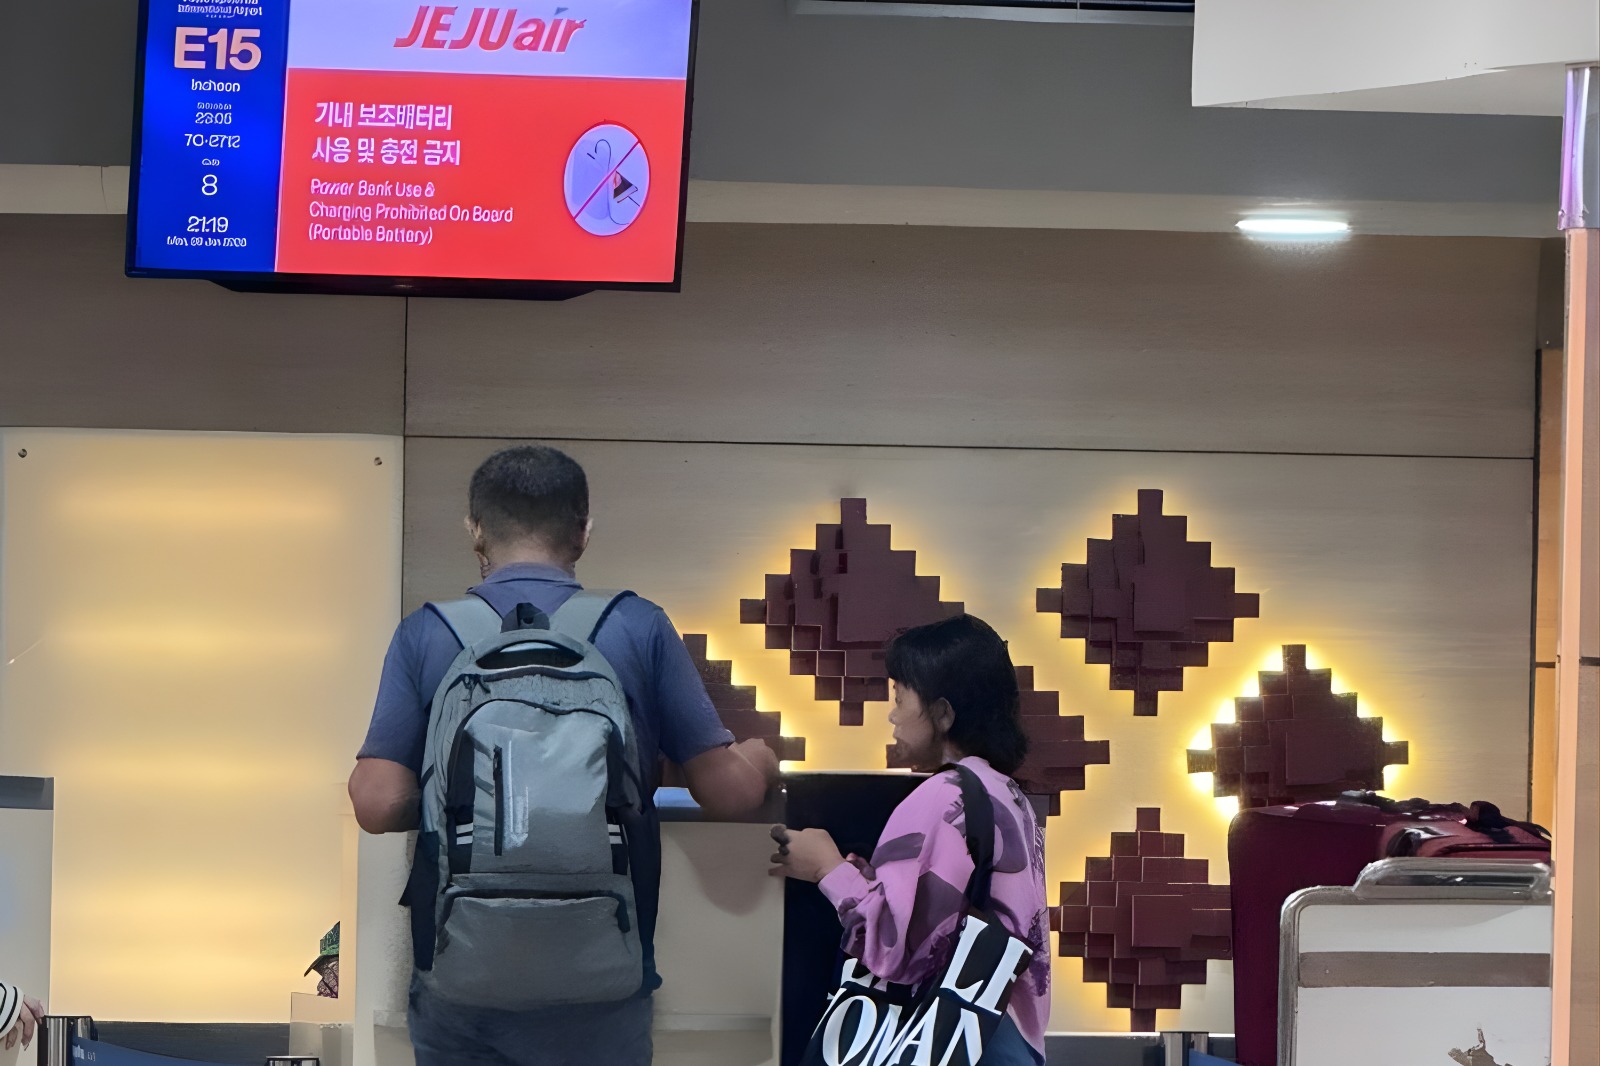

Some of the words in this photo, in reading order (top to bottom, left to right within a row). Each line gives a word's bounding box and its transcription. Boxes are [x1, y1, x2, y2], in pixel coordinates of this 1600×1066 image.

[174, 26, 262, 71] E15
[314, 101, 353, 128] 기내
[357, 103, 453, 131] 보조배터리
[311, 136, 352, 163] 사용
[357, 137, 375, 164] 및
[380, 137, 418, 165] 충전
[423, 139, 461, 166] 금지
[201, 174, 218, 196] 8
[310, 178, 354, 196] Power
[358, 180, 393, 197] Bank
[395, 182, 421, 198] Use
[424, 181, 435, 198] &
[309, 201, 372, 222] Charging
[375, 203, 447, 221] Prohibited
[449, 204, 470, 221] On
[472, 205, 514, 223] Board
[308, 222, 373, 242] (Portable
[375, 225, 434, 246] Battery)
